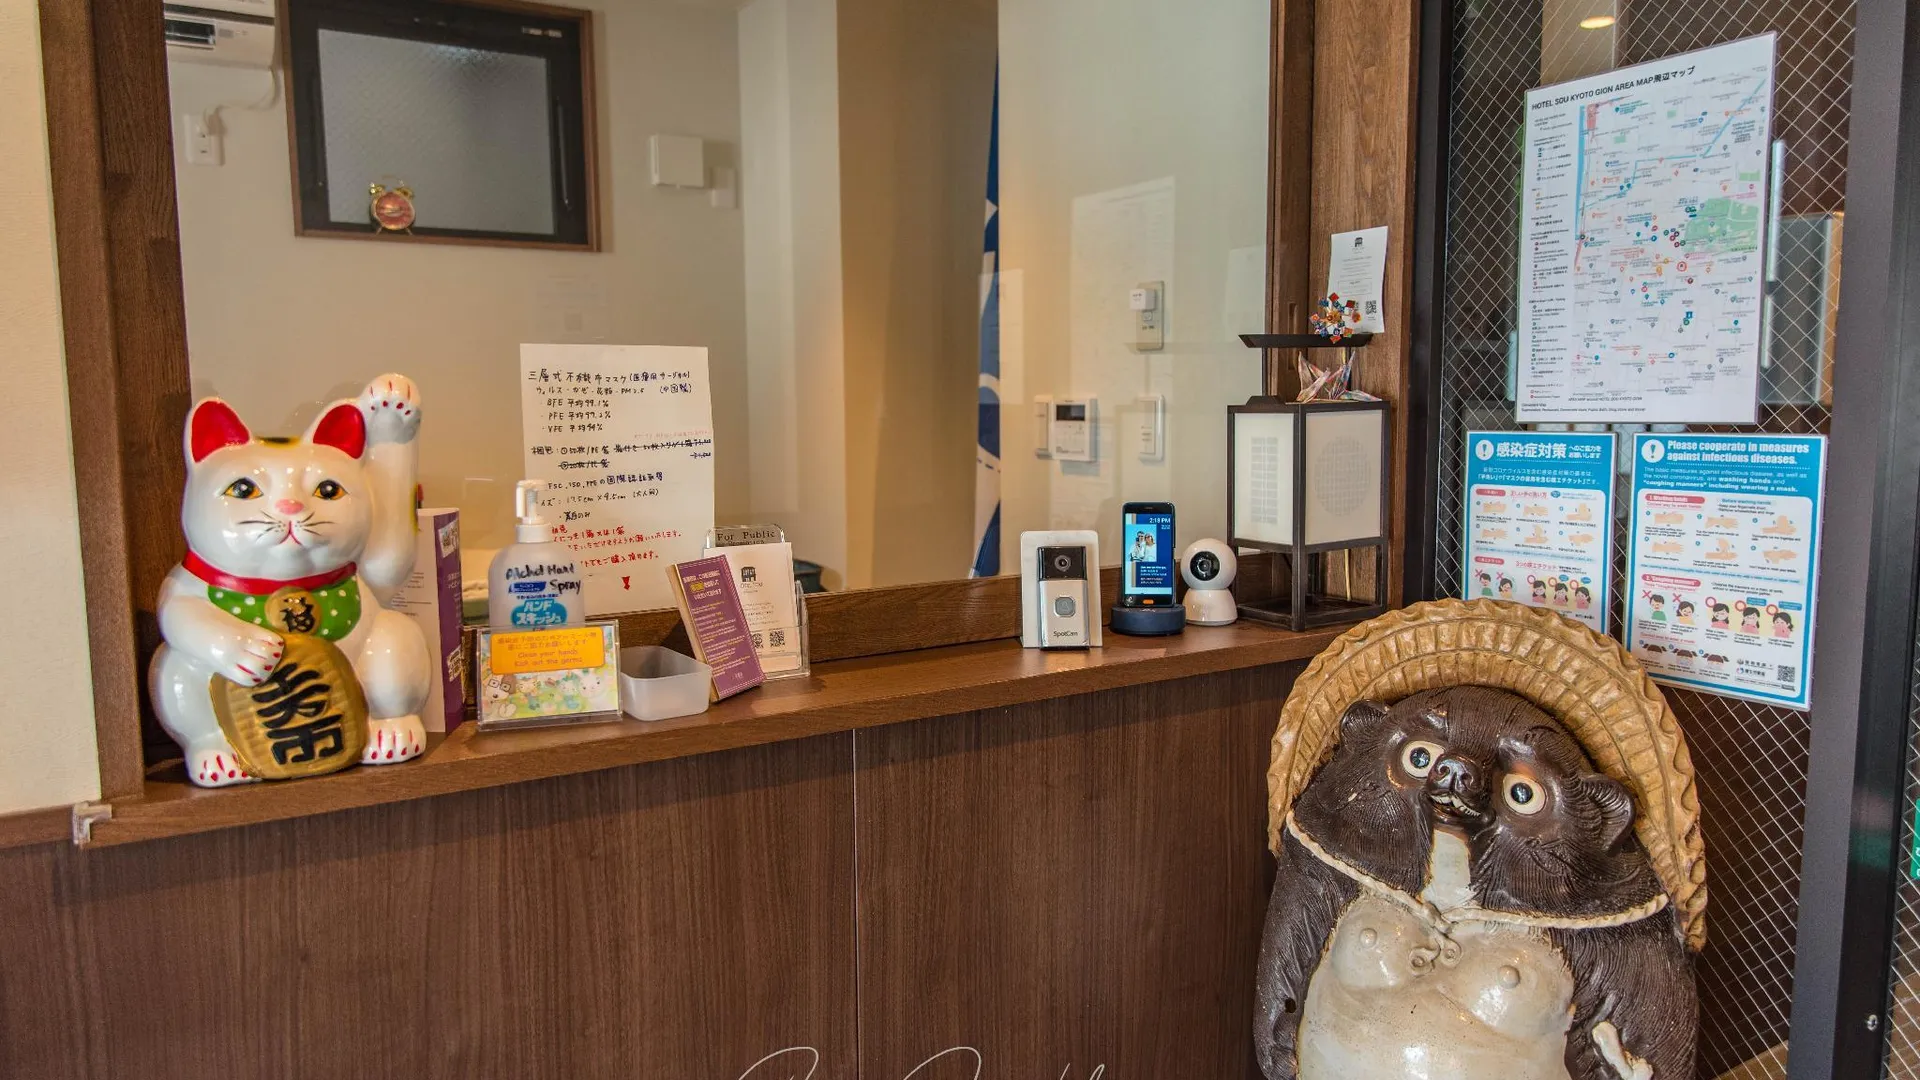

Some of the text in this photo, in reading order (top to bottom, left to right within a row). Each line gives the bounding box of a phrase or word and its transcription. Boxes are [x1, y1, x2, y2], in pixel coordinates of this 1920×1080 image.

[1532, 101, 1554, 111] HOTEL
[1555, 96, 1569, 106] SOU
[1570, 90, 1594, 101] KYOTO
[1595, 86, 1614, 96] GION
[1614, 81, 1635, 91] AREA
[1497, 442, 1567, 459] 感染症対策
[1667, 440, 1810, 453] Please cooperate in measures
[1667, 452, 1798, 464] against infectious diseases.
[1708, 482, 1739, 490] including
[717, 530, 776, 541] For Public
[547, 563, 575, 575] Hand
[549, 578, 582, 595] Spray
[523, 600, 553, 613] ハンド
[280, 597, 316, 633] 福
[515, 611, 562, 625] スキッシュ
[1053, 630, 1079, 638] SpotCam
[539, 651, 556, 659] your
